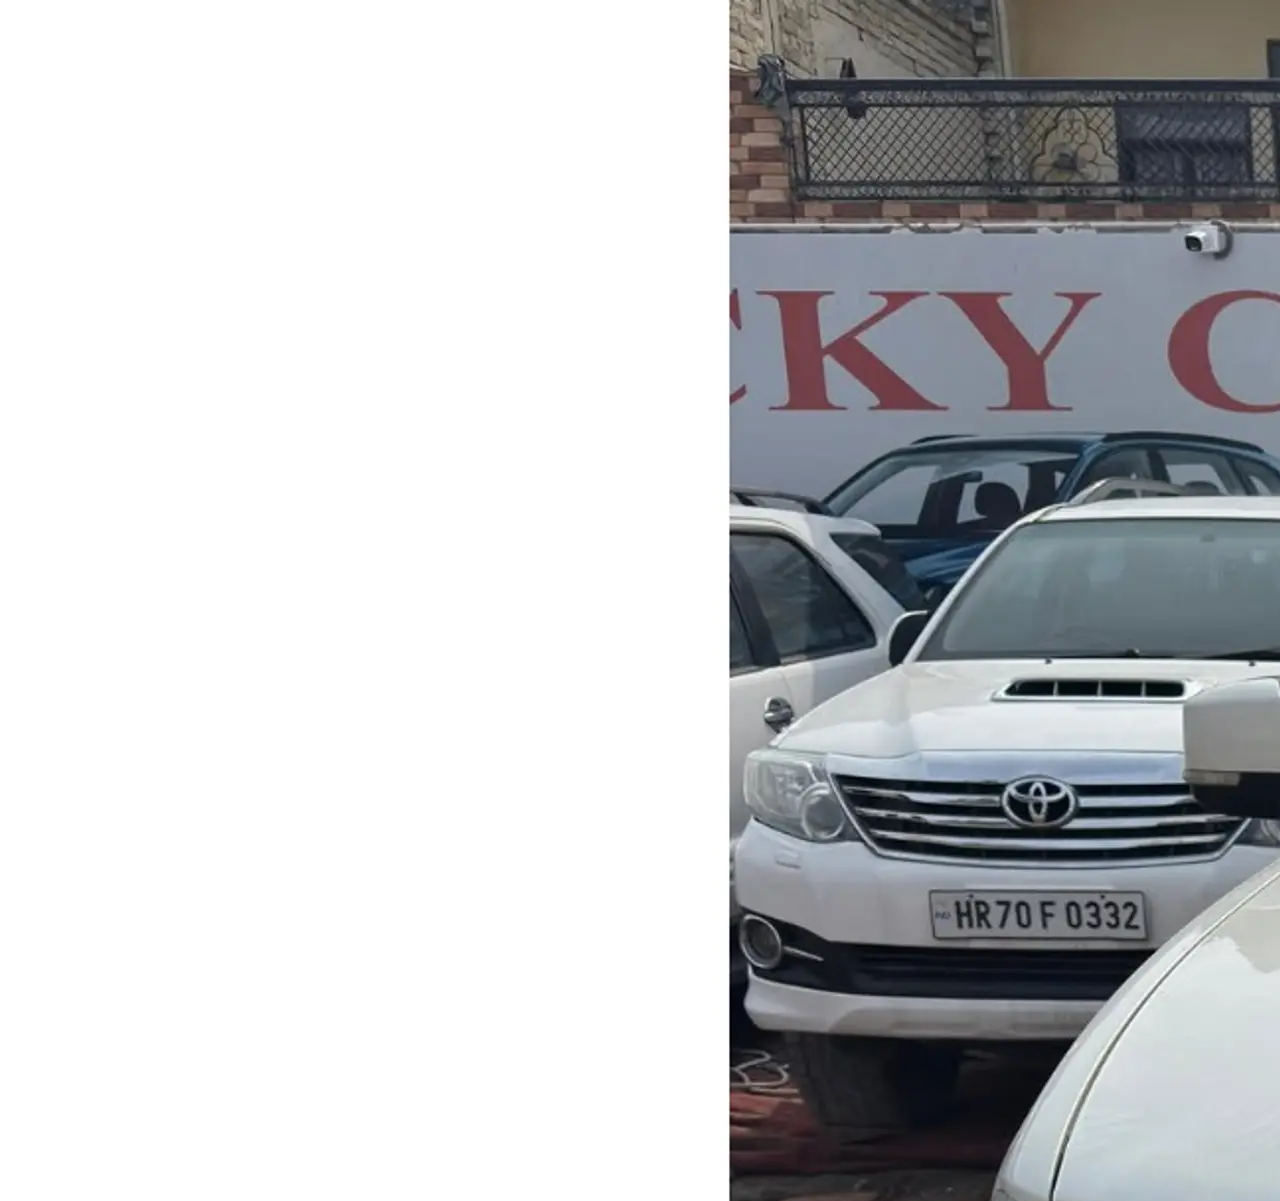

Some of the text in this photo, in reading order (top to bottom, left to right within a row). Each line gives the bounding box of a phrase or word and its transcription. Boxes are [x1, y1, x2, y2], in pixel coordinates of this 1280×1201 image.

[729, 287, 1102, 412] KY
[1040, 900, 1056, 930] F
[1065, 900, 1141, 930] 0332
